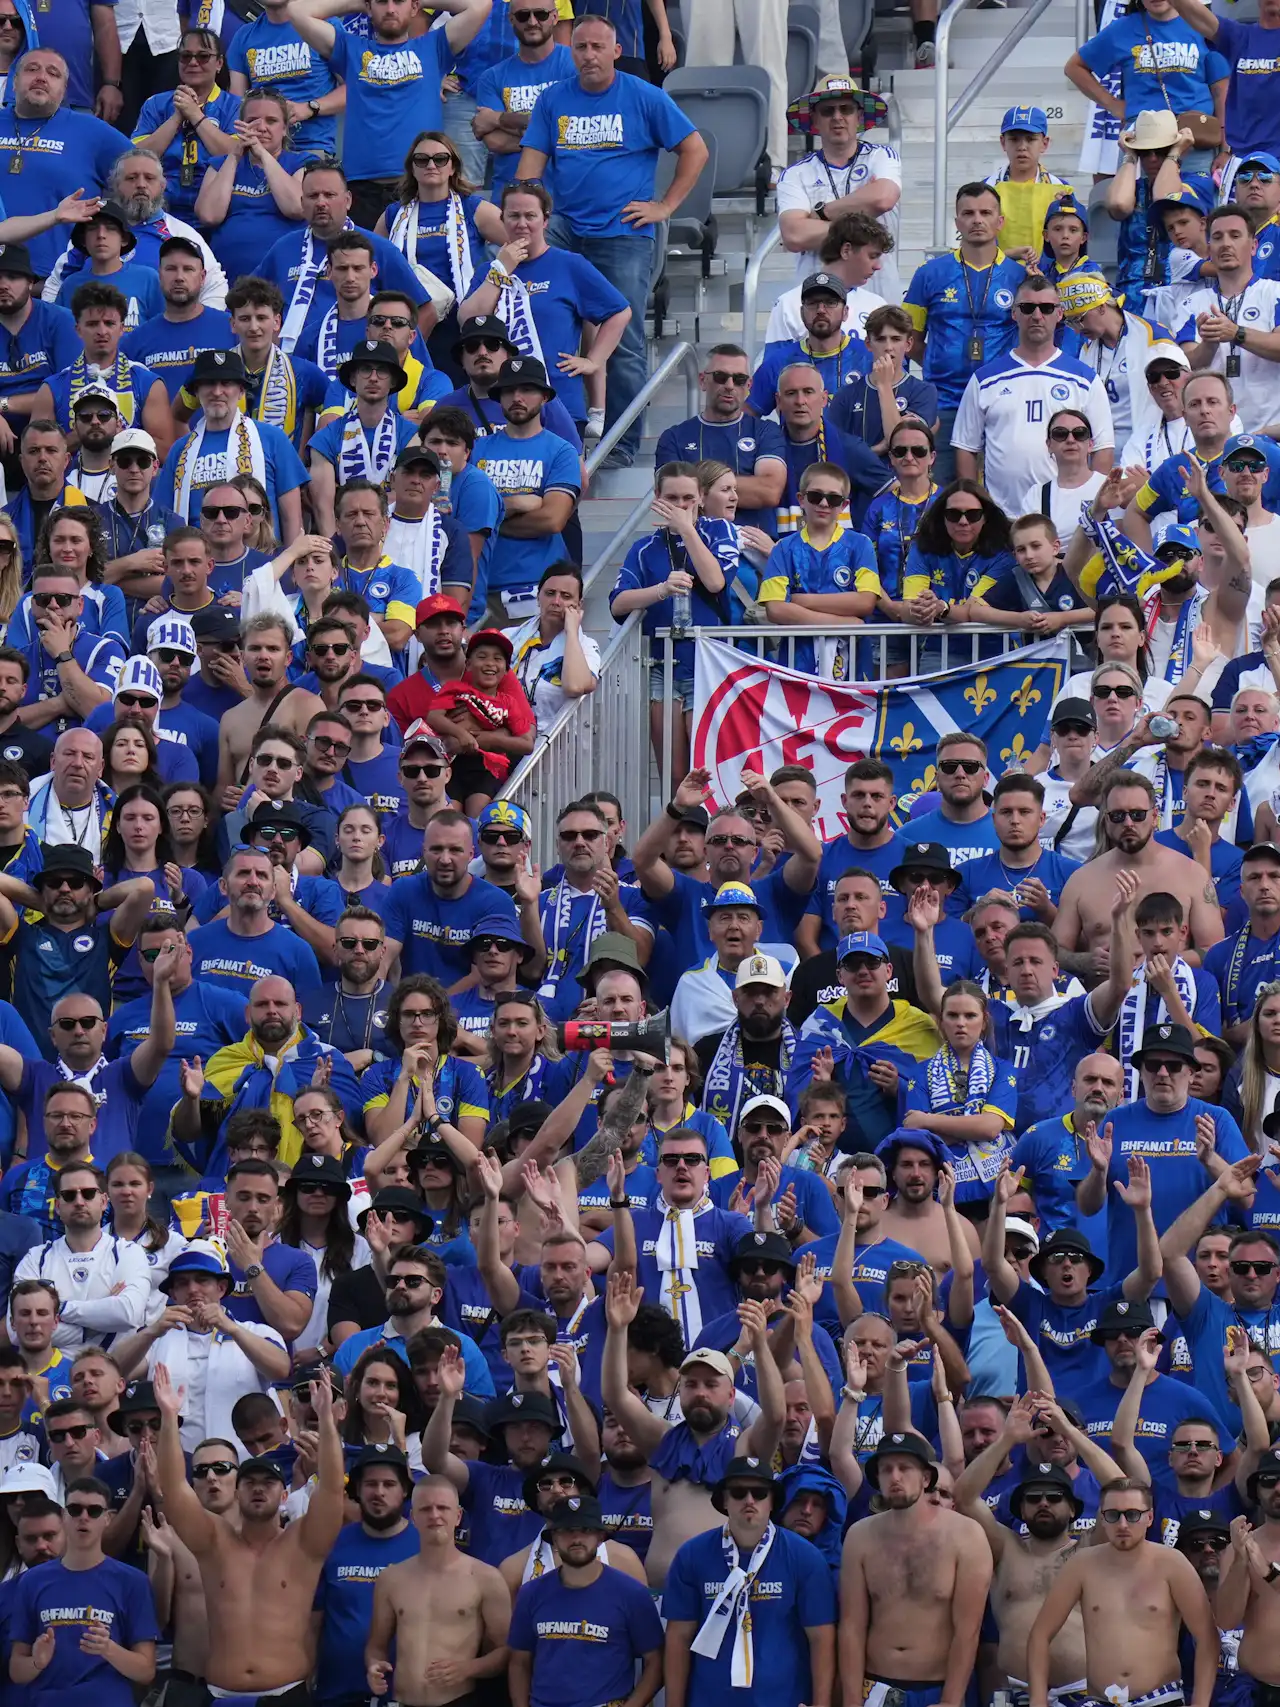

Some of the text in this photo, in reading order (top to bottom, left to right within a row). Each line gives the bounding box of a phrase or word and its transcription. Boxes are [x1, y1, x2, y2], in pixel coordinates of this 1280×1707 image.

[253, 42, 311, 66] BOSNA
[368, 50, 422, 72] BOSNA
[1140, 42, 1199, 60] BOSNA
[251, 60, 312, 77] HERCEGOVINA
[1046, 107, 1064, 119] 28
[567, 113, 624, 136] BOSNA
[566, 130, 624, 145] HERCEGOVINA
[1026, 400, 1043, 423] 10
[194, 451, 228, 472] BOS
[486, 460, 543, 479] BOSNA
[1014, 1046, 1030, 1069] 11
[537, 1620, 609, 1639] BHFANATICOS
